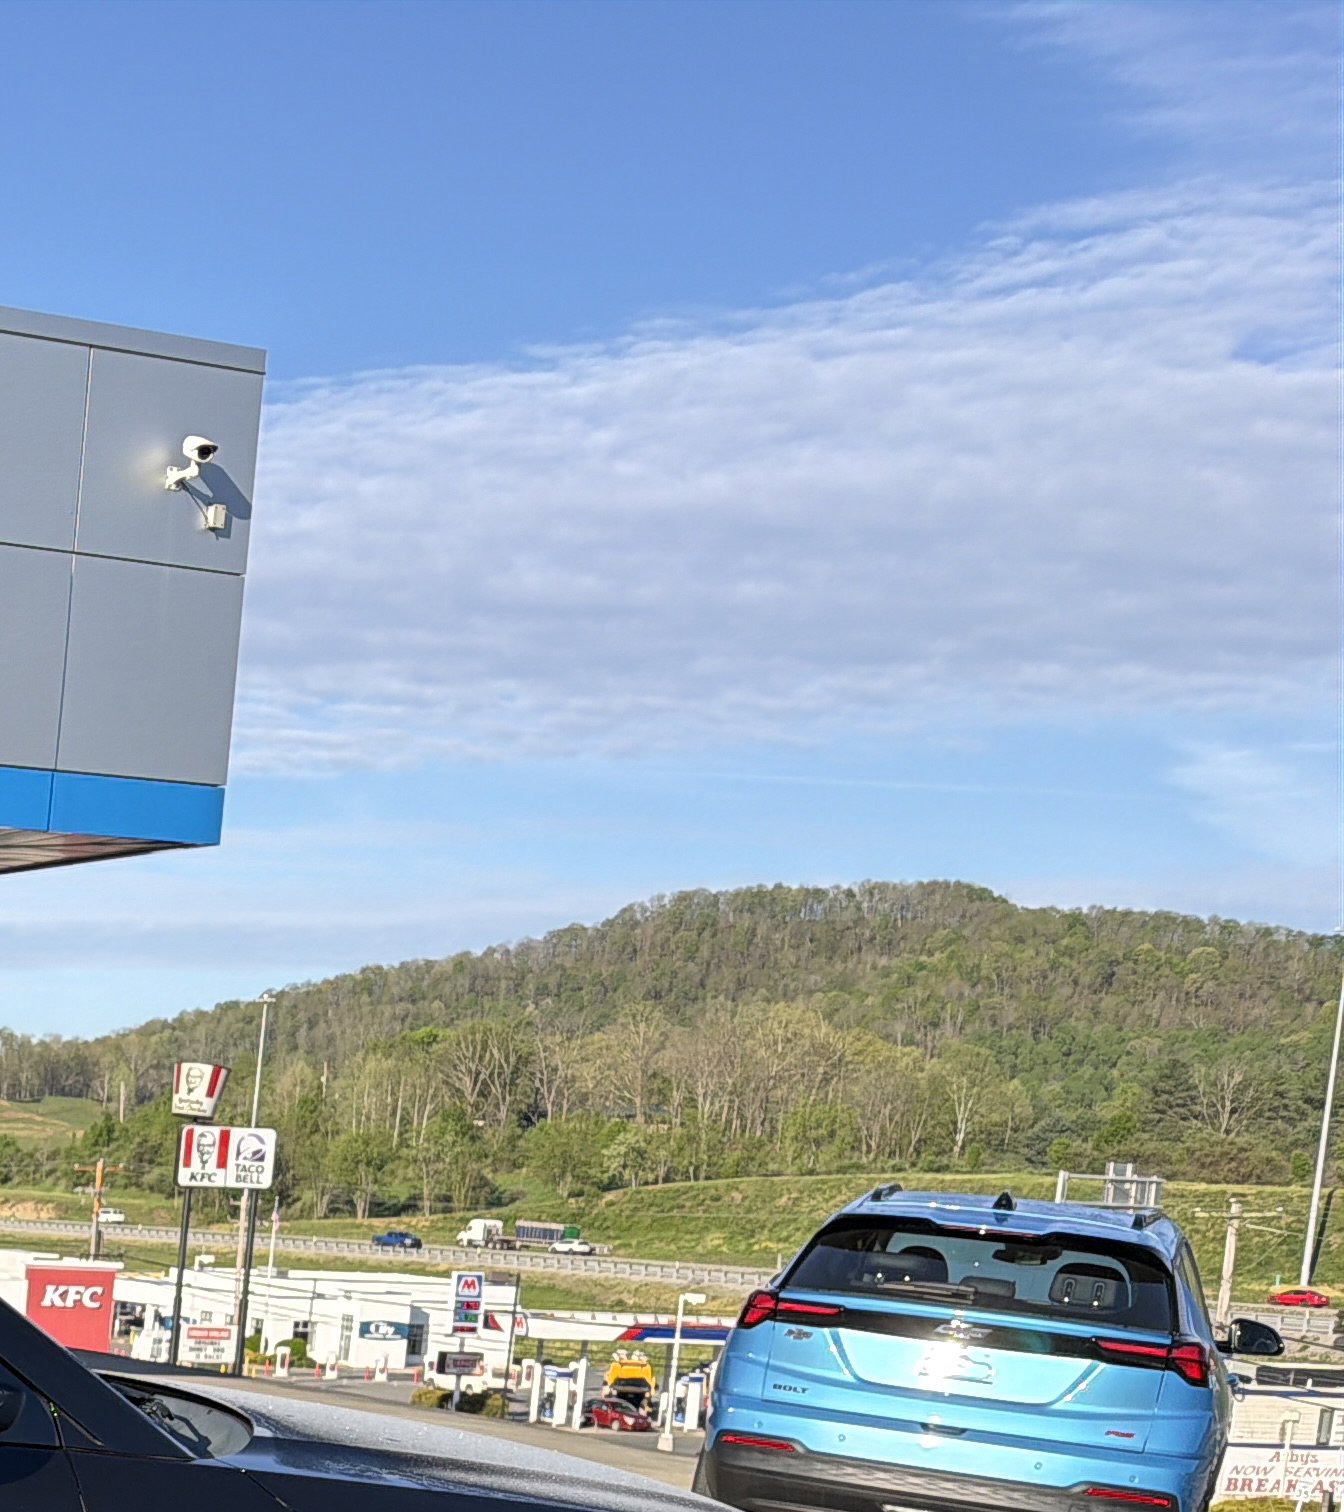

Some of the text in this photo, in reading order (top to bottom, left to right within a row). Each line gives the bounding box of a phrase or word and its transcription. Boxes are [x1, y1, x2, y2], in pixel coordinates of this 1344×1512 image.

[235, 1163, 265, 1174] TACO
[189, 1171, 217, 1183] KFC
[235, 1174, 263, 1184] BELL
[40, 1285, 104, 1309] KFC
[773, 1384, 809, 1394] BOLT
[1229, 1465, 1275, 1476] NOW
